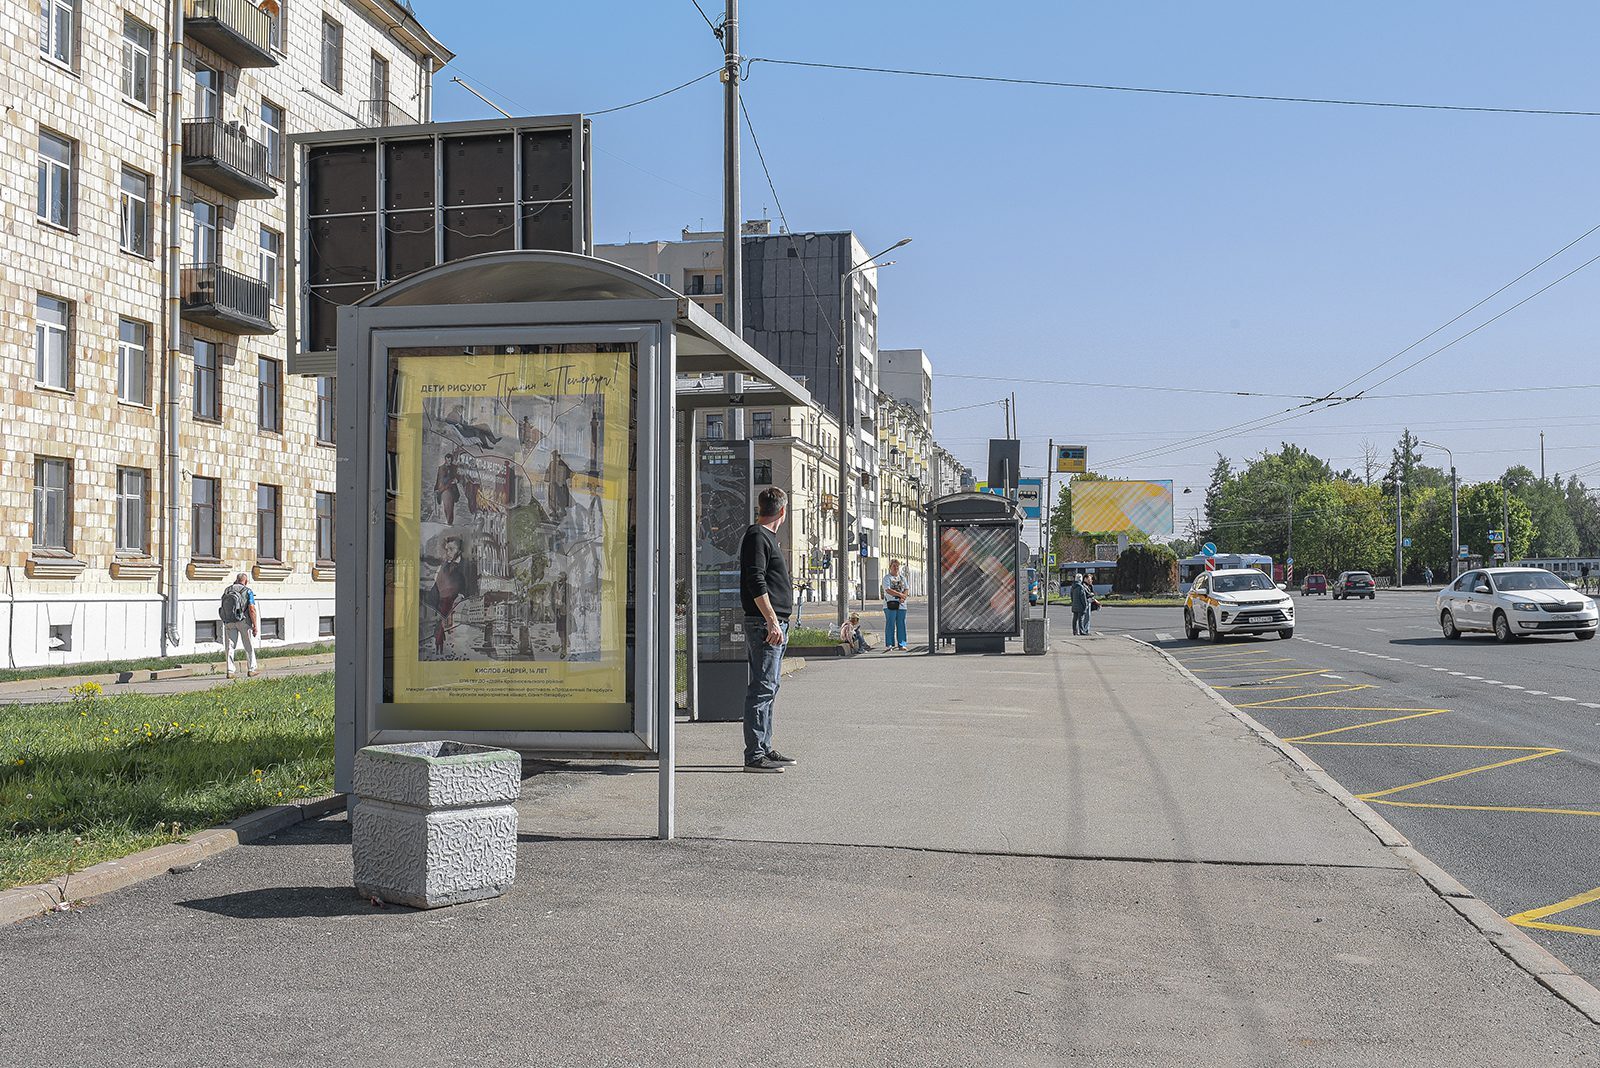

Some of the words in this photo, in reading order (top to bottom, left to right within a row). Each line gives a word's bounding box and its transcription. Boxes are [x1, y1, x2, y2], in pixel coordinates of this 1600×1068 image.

[420, 384, 445, 393] ДЕТИ
[447, 383, 488, 392] РИСУЮТ
[488, 371, 536, 409] Пушкин
[502, 666, 528, 674] АНДРЕЙ,
